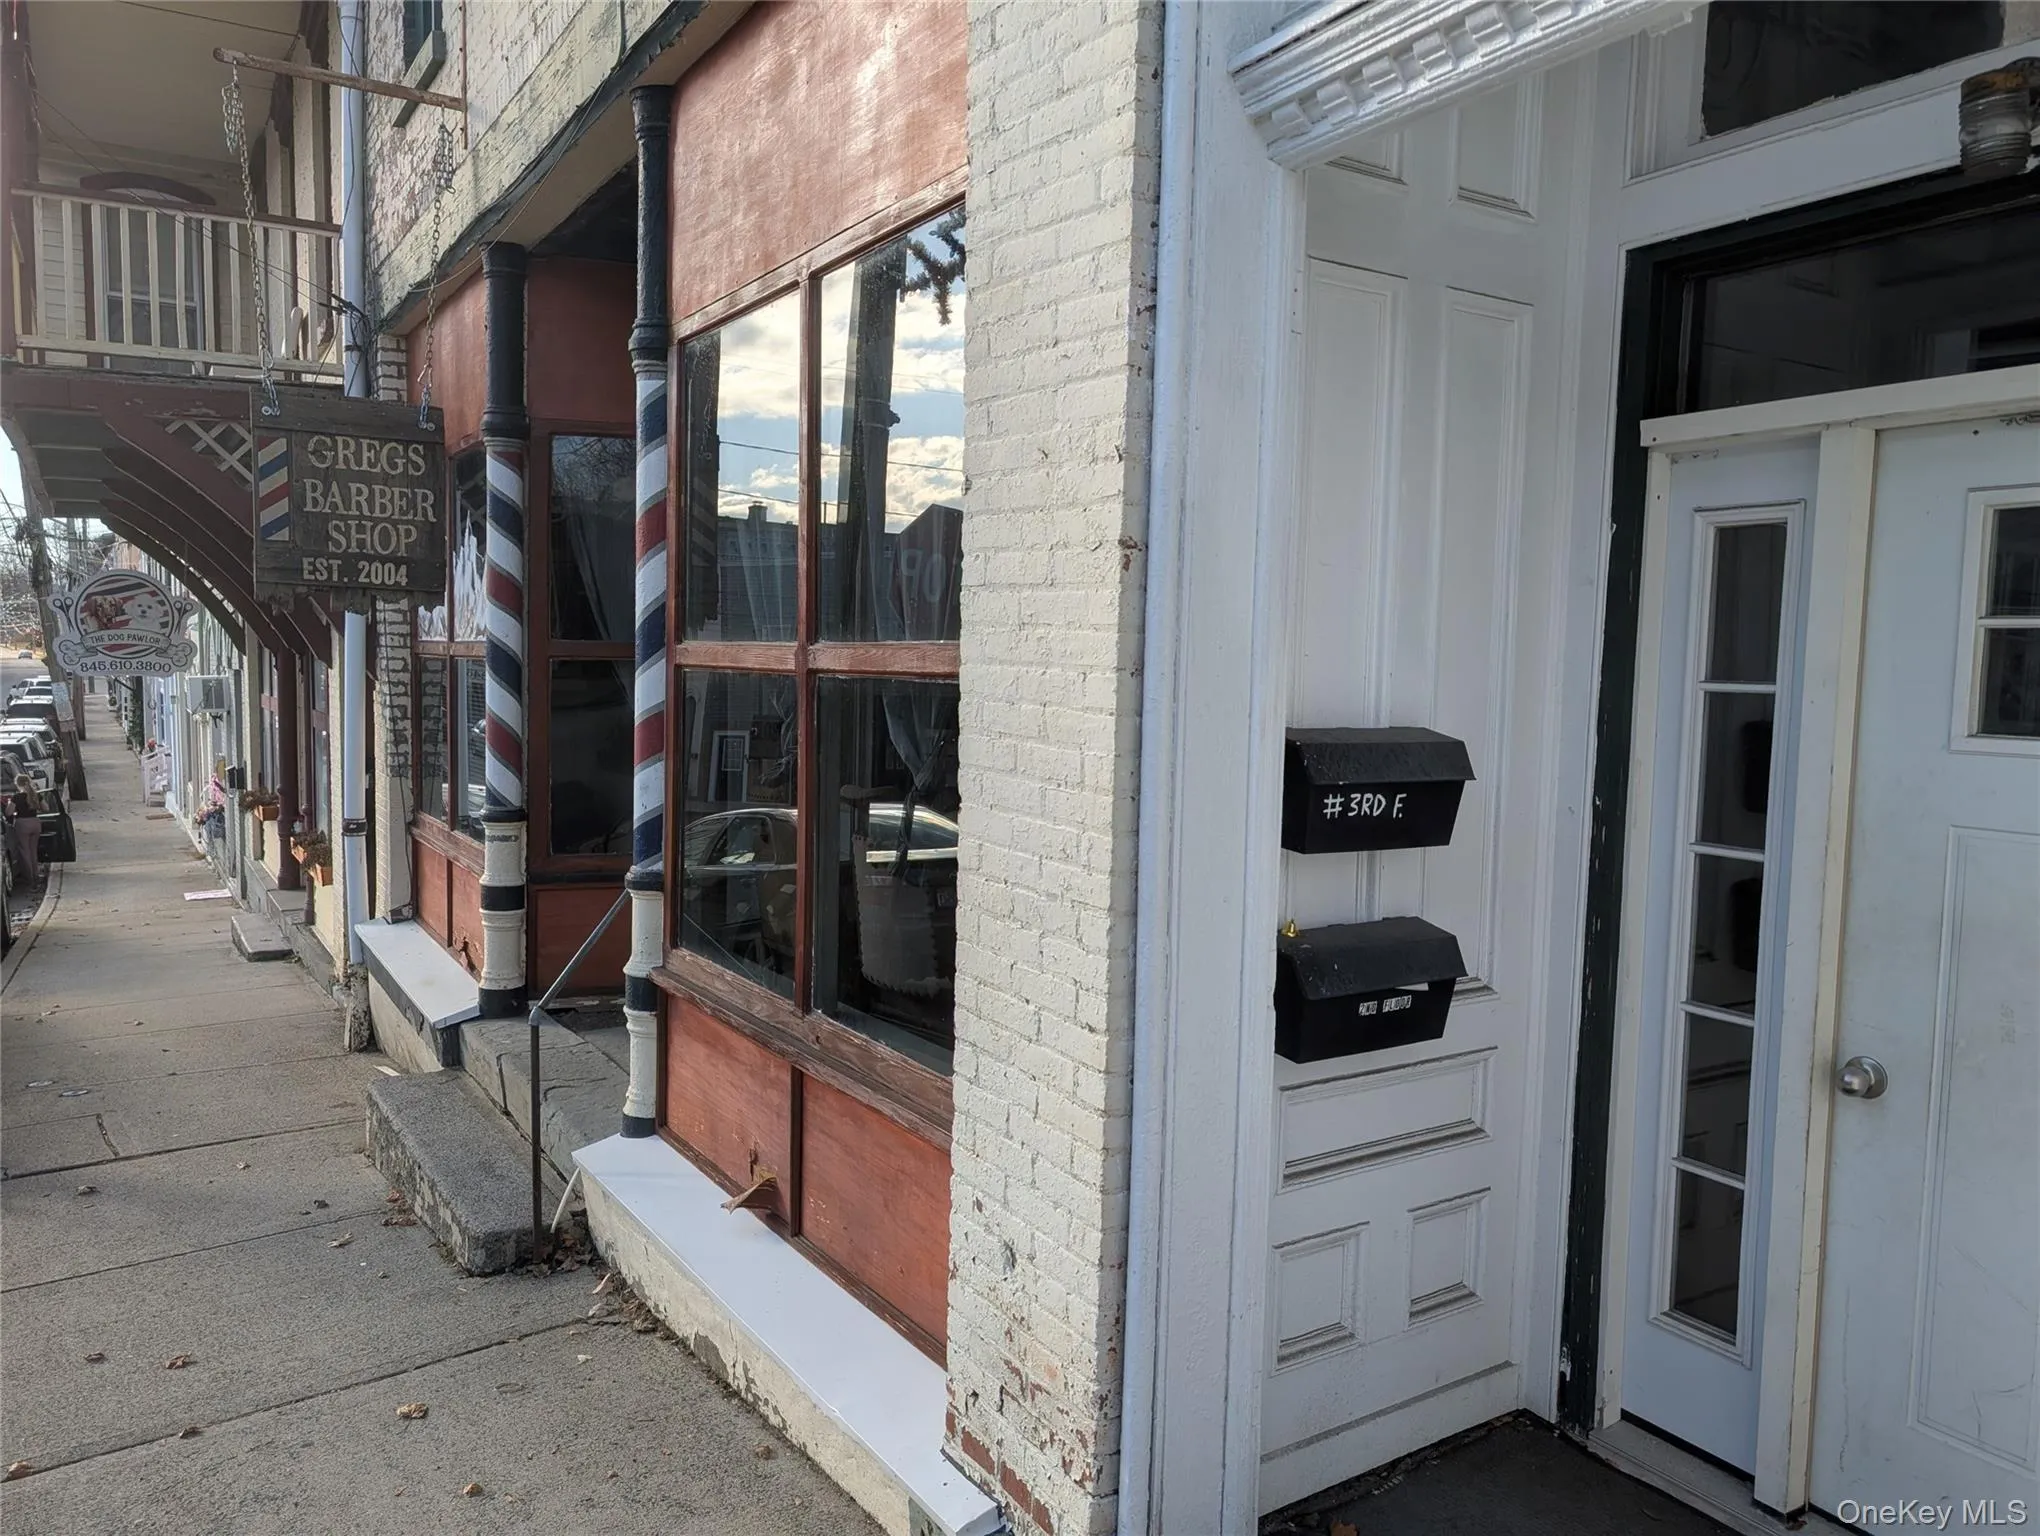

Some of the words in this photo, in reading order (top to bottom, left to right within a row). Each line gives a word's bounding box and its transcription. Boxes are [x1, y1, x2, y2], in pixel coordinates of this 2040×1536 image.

[307, 434, 426, 476] GREGS
[303, 478, 437, 522] BARBER
[327, 520, 418, 557] SHOP
[302, 556, 349, 583] EST.
[358, 560, 408, 586] 2004
[89, 633, 106, 645] THE
[108, 632, 125, 642] DOG
[127, 633, 161, 645] PAWLOR
[80, 660, 172, 673] 845.610.3800
